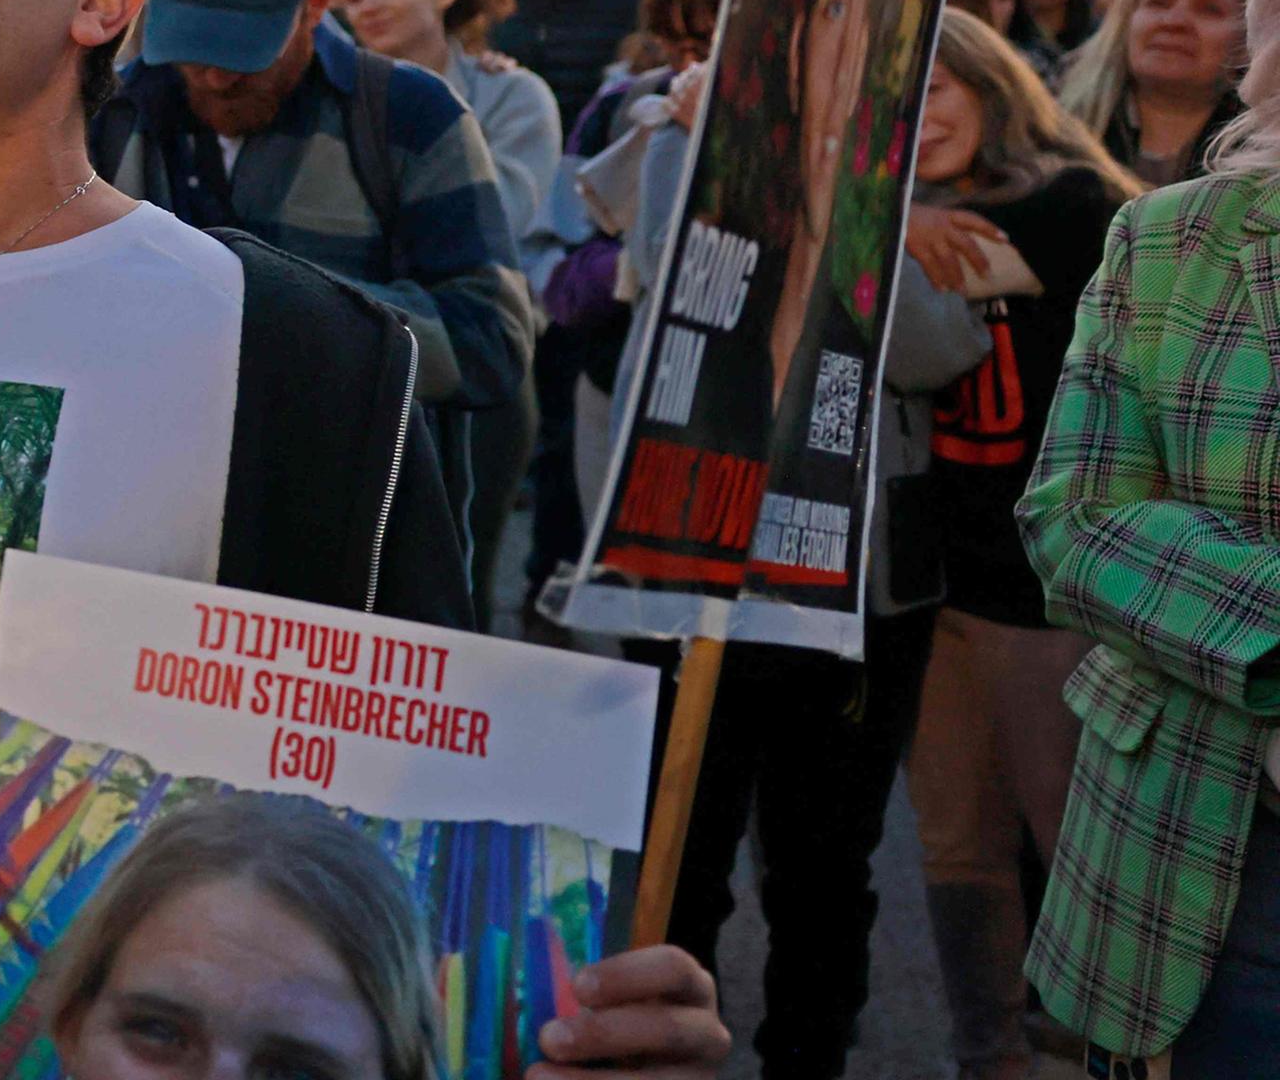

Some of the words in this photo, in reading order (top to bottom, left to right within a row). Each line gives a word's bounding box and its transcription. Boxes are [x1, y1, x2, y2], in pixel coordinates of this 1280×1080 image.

[670, 219, 759, 331] BRING
[646, 324, 707, 426] HIM
[799, 528, 848, 573] FORUM
[194, 603, 360, 675] שטיינברכר
[370, 635, 450, 693] דורון
[134, 647, 245, 711] DORON
[250, 670, 491, 758] STEINBRECHER
[268, 727, 337, 789] (30)
